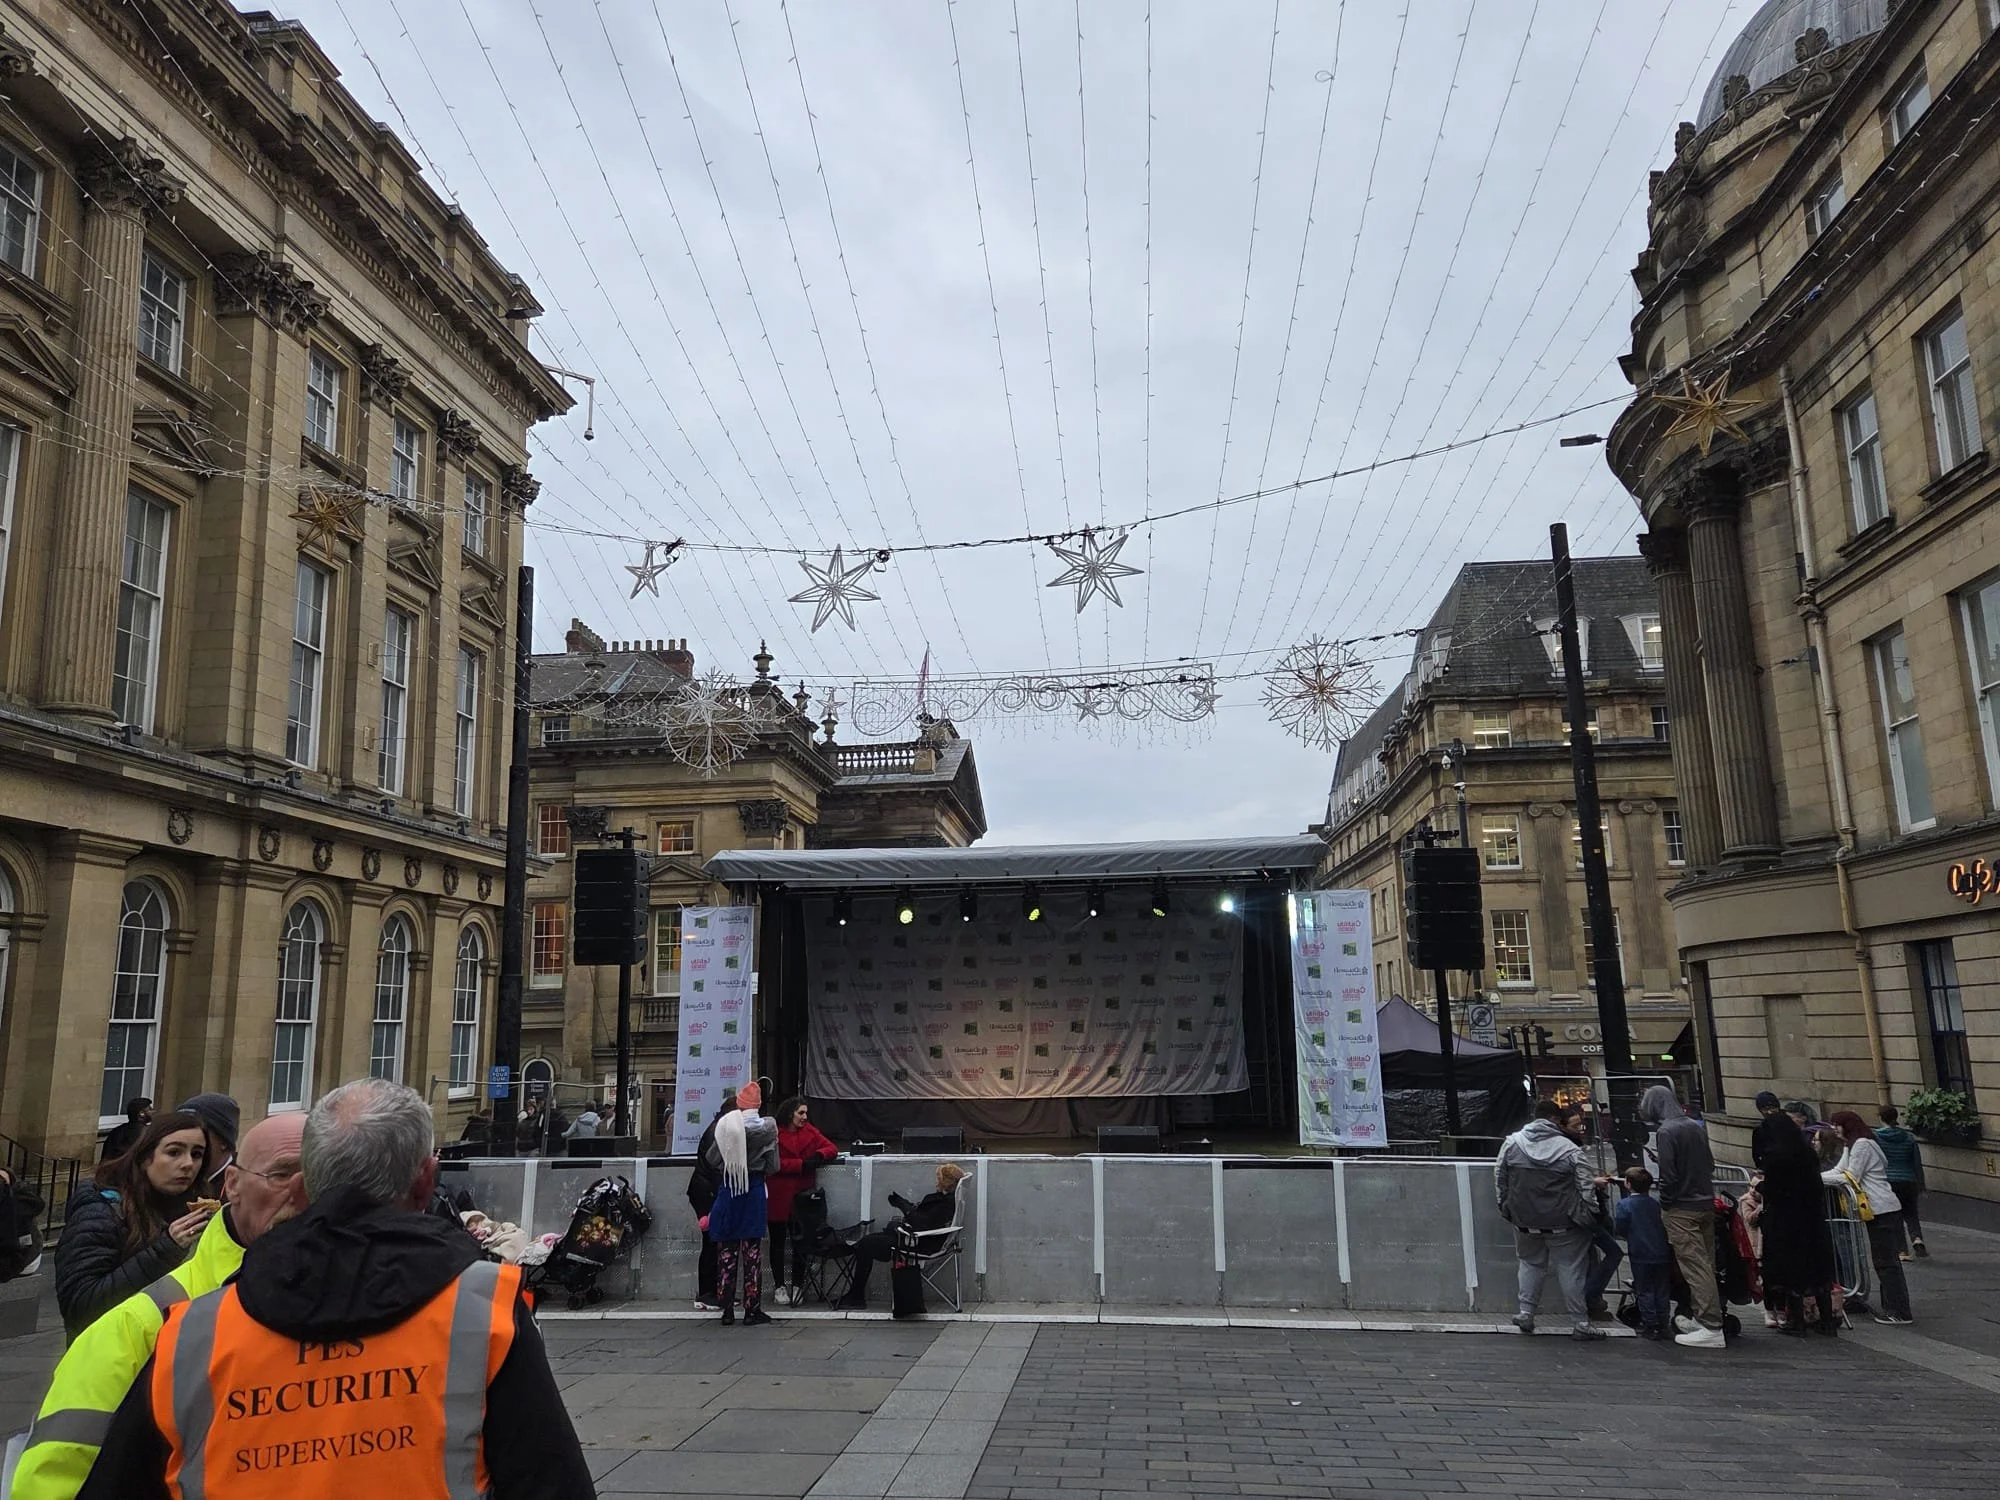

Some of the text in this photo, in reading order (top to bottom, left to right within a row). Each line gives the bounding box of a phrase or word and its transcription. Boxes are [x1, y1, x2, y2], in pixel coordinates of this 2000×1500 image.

[1564, 1024, 1639, 1041] COA
[296, 1339, 366, 1365] PES
[226, 1365, 430, 1421] SECURITY
[235, 1424, 417, 1473] SUPERVISOR
